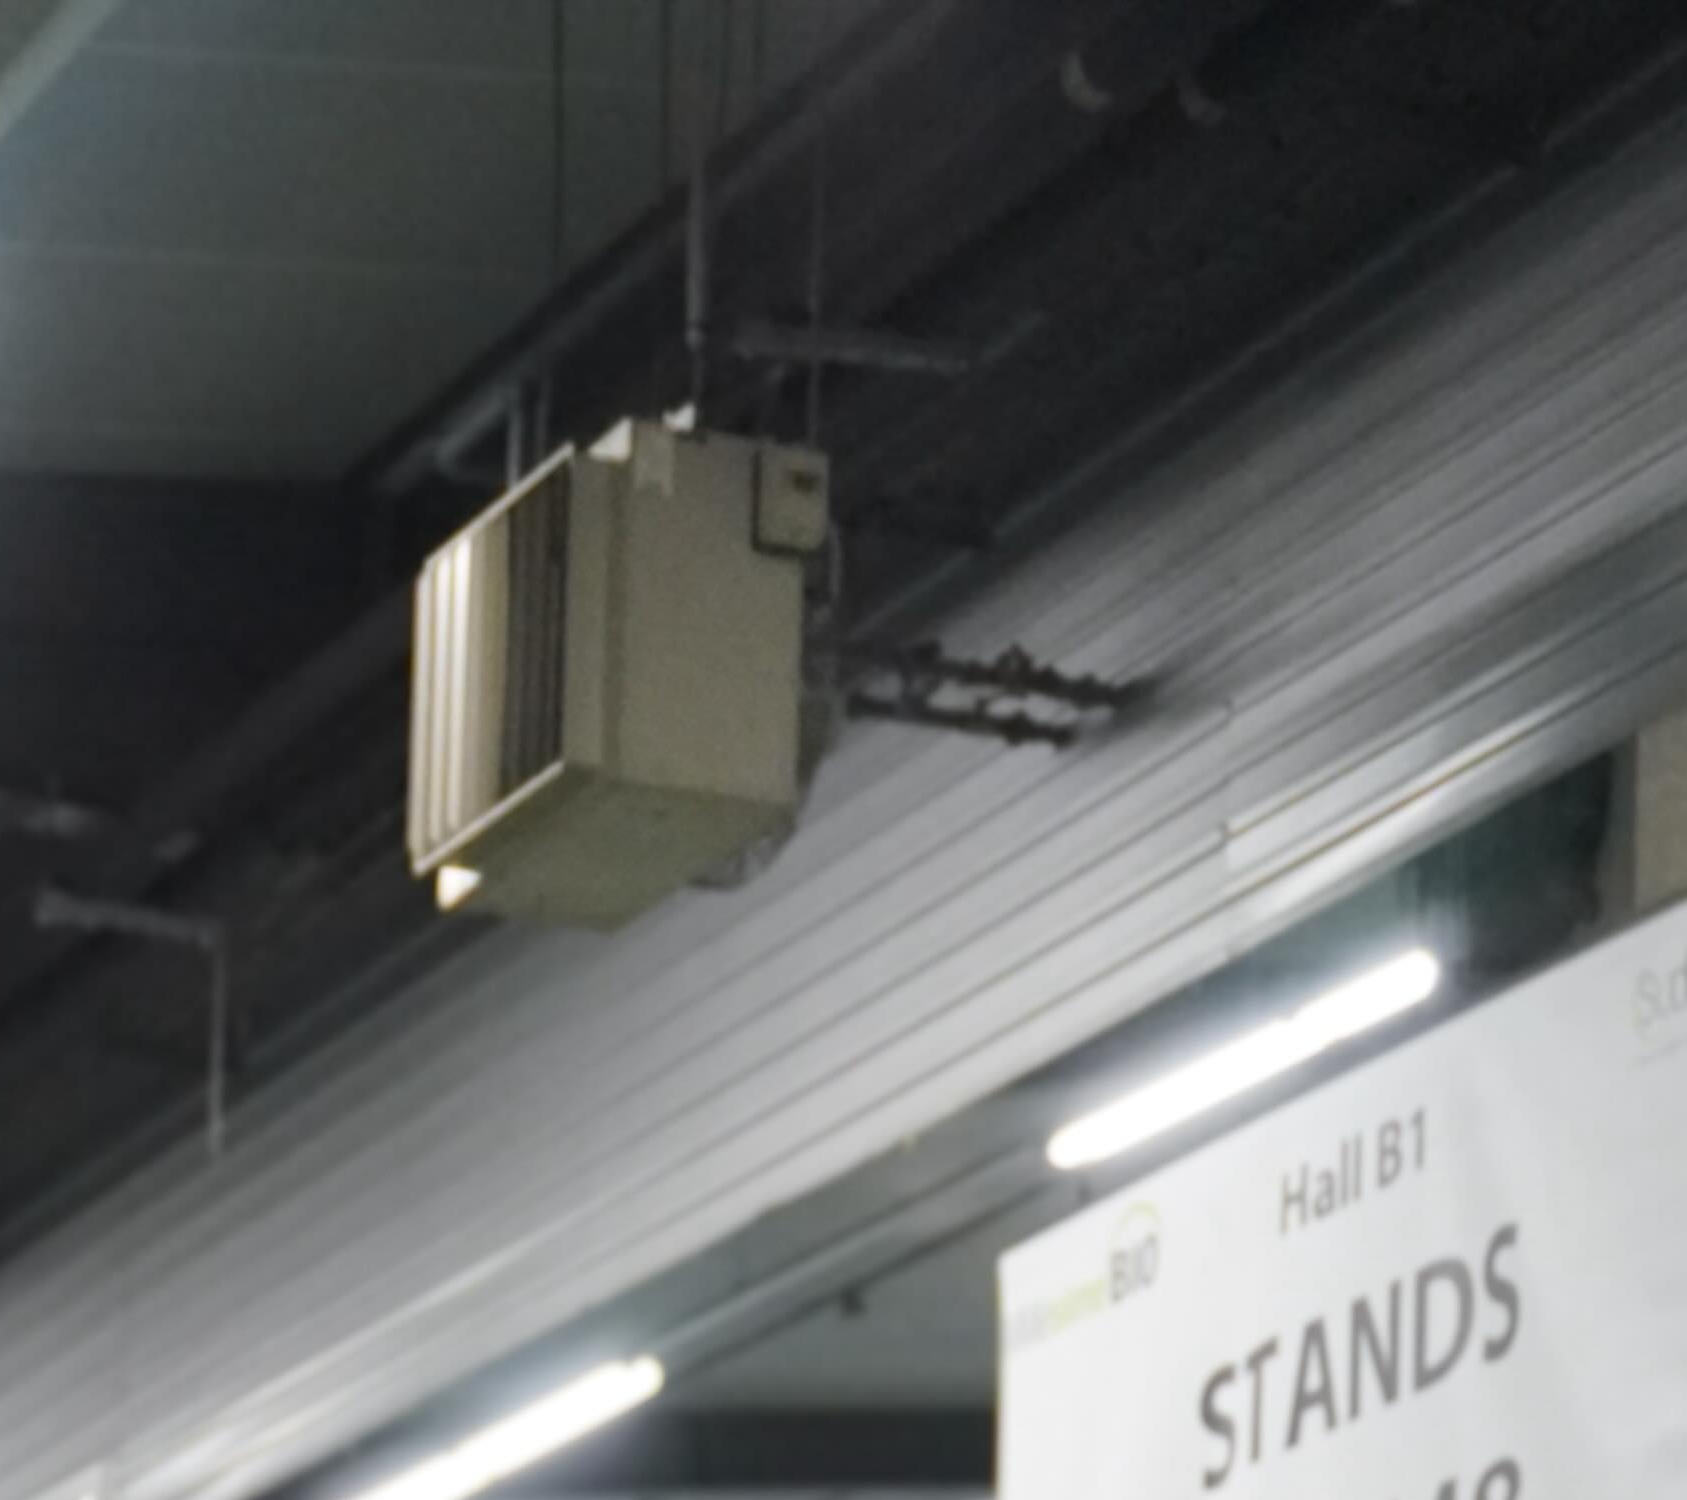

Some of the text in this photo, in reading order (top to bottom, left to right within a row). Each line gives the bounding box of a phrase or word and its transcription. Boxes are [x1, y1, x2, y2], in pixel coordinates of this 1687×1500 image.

[1279, 1108, 1427, 1236] Hall B1
[1199, 1222, 1519, 1491] STANDS
